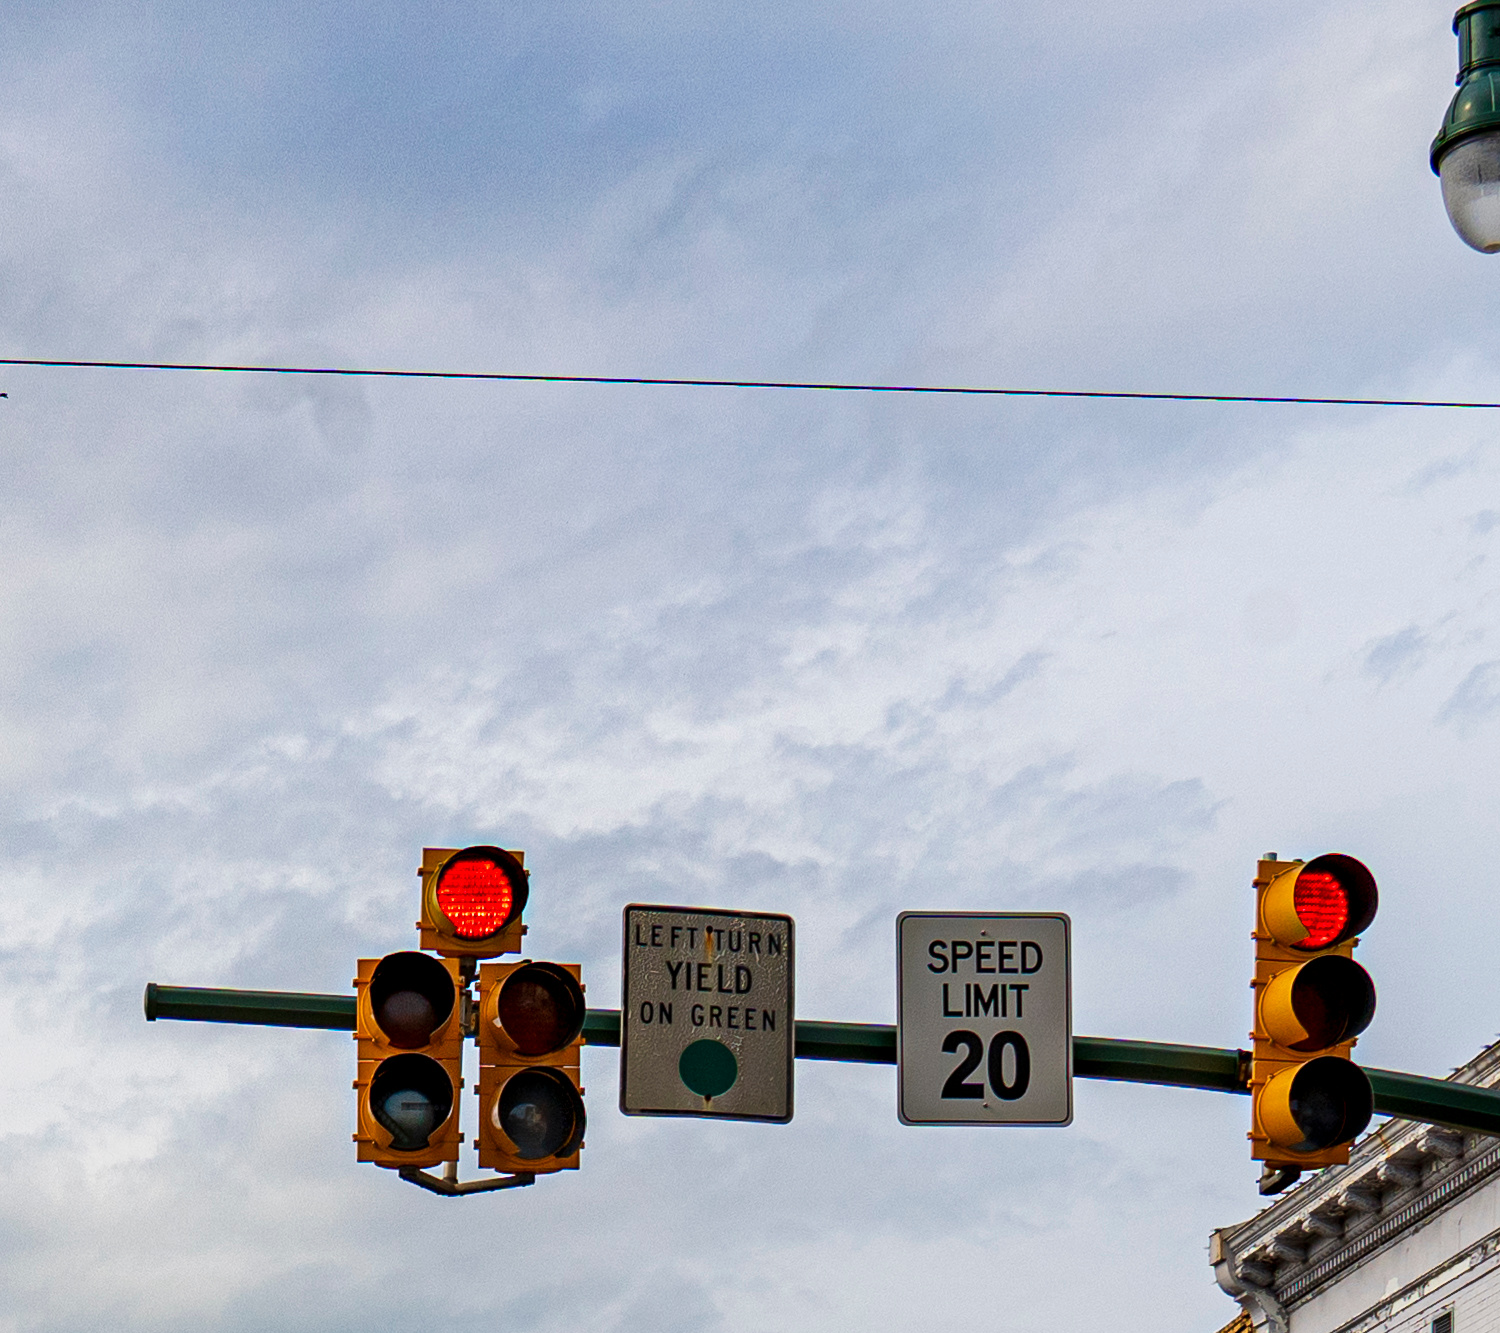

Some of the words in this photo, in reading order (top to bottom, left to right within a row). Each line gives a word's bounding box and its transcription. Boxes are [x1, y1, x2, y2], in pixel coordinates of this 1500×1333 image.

[635, 924, 698, 949] LEFT
[713, 929, 782, 955] TURN
[927, 939, 1043, 974] SPEED
[666, 960, 752, 995] YIELD
[640, 1001, 673, 1025] ON
[691, 1003, 776, 1032] GREEN
[942, 983, 1029, 1018] LIMIT
[940, 1029, 1031, 1101] 20
